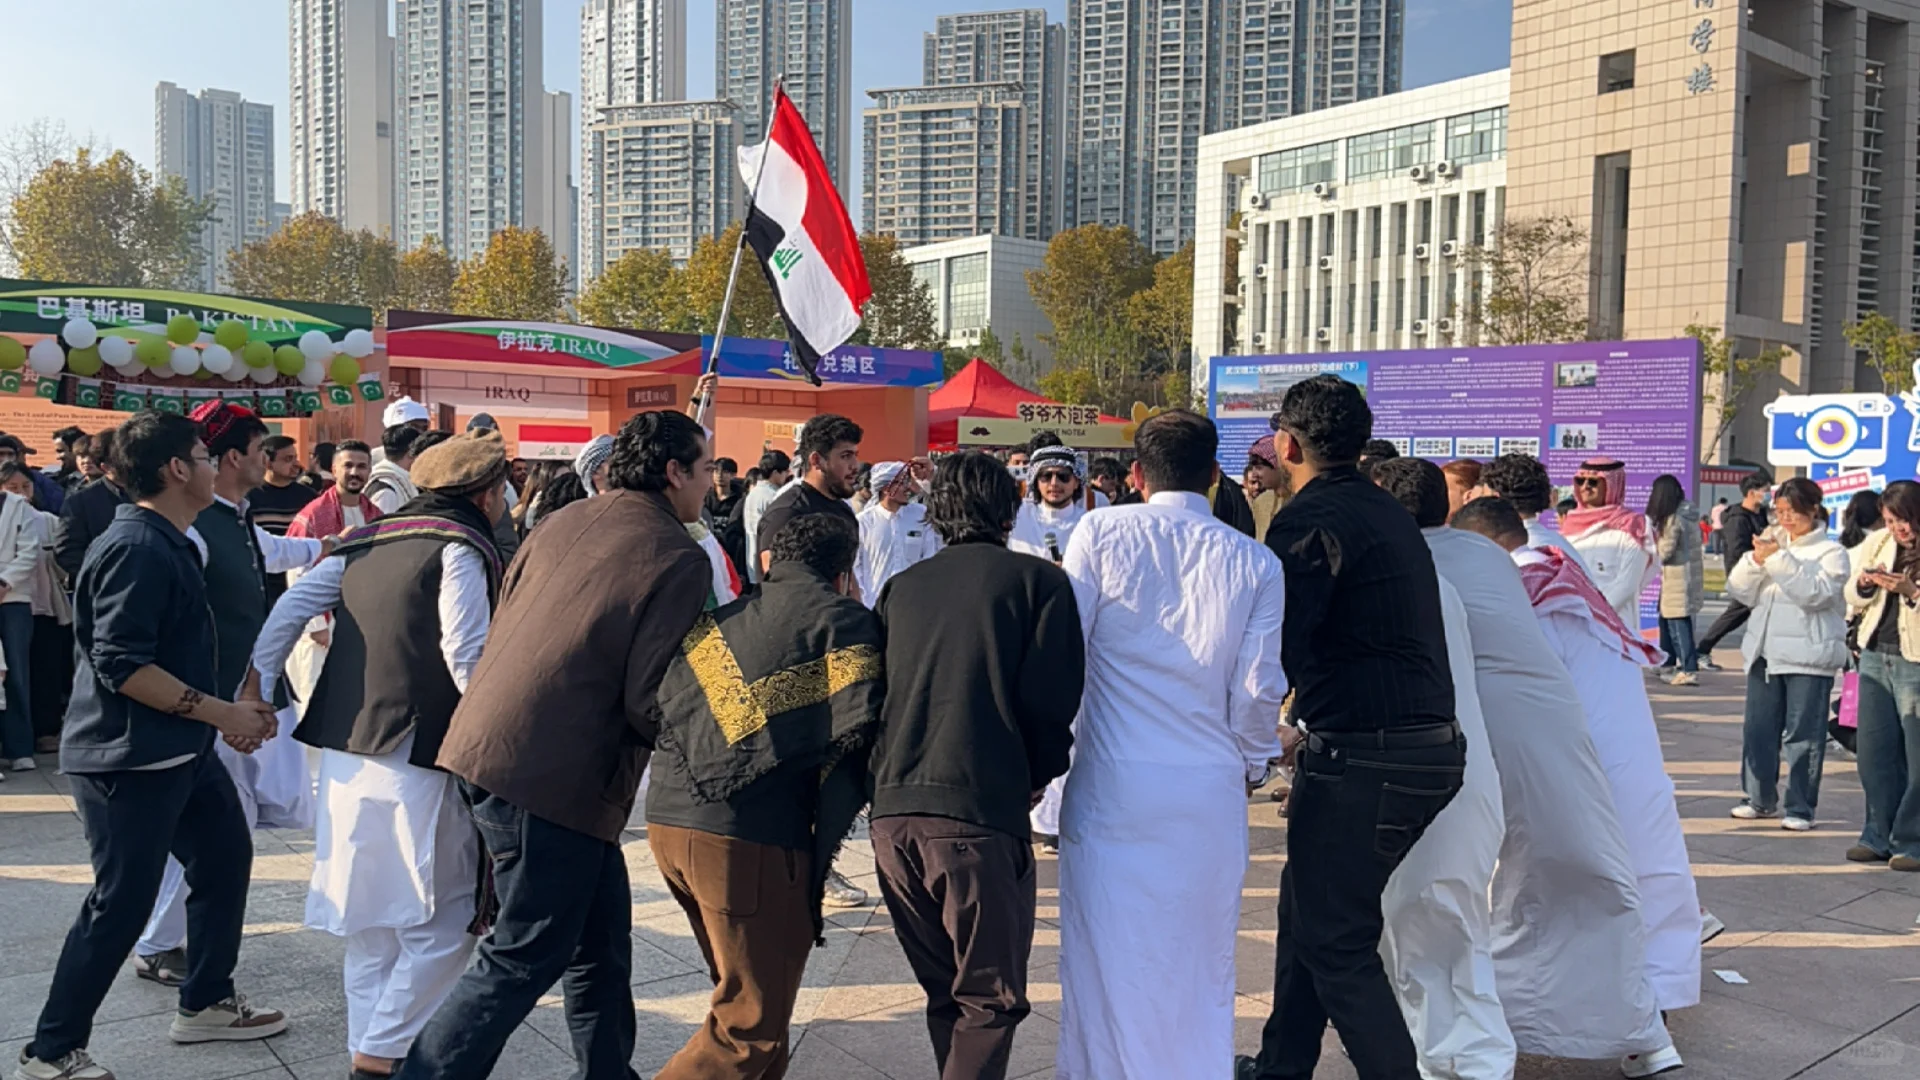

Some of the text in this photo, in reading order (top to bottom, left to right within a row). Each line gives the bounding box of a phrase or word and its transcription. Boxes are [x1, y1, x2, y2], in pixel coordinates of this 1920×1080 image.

[37, 296, 146, 323] 巴基斯坦
[165, 307, 296, 333] PAKISTAN
[497, 330, 556, 353] 伊拉克
[561, 337, 610, 359] IRAQ
[783, 351, 875, 374] 礼兑换区
[485, 385, 530, 403] IRAQ
[1019, 403, 1099, 425] 爷爷不泡茶
